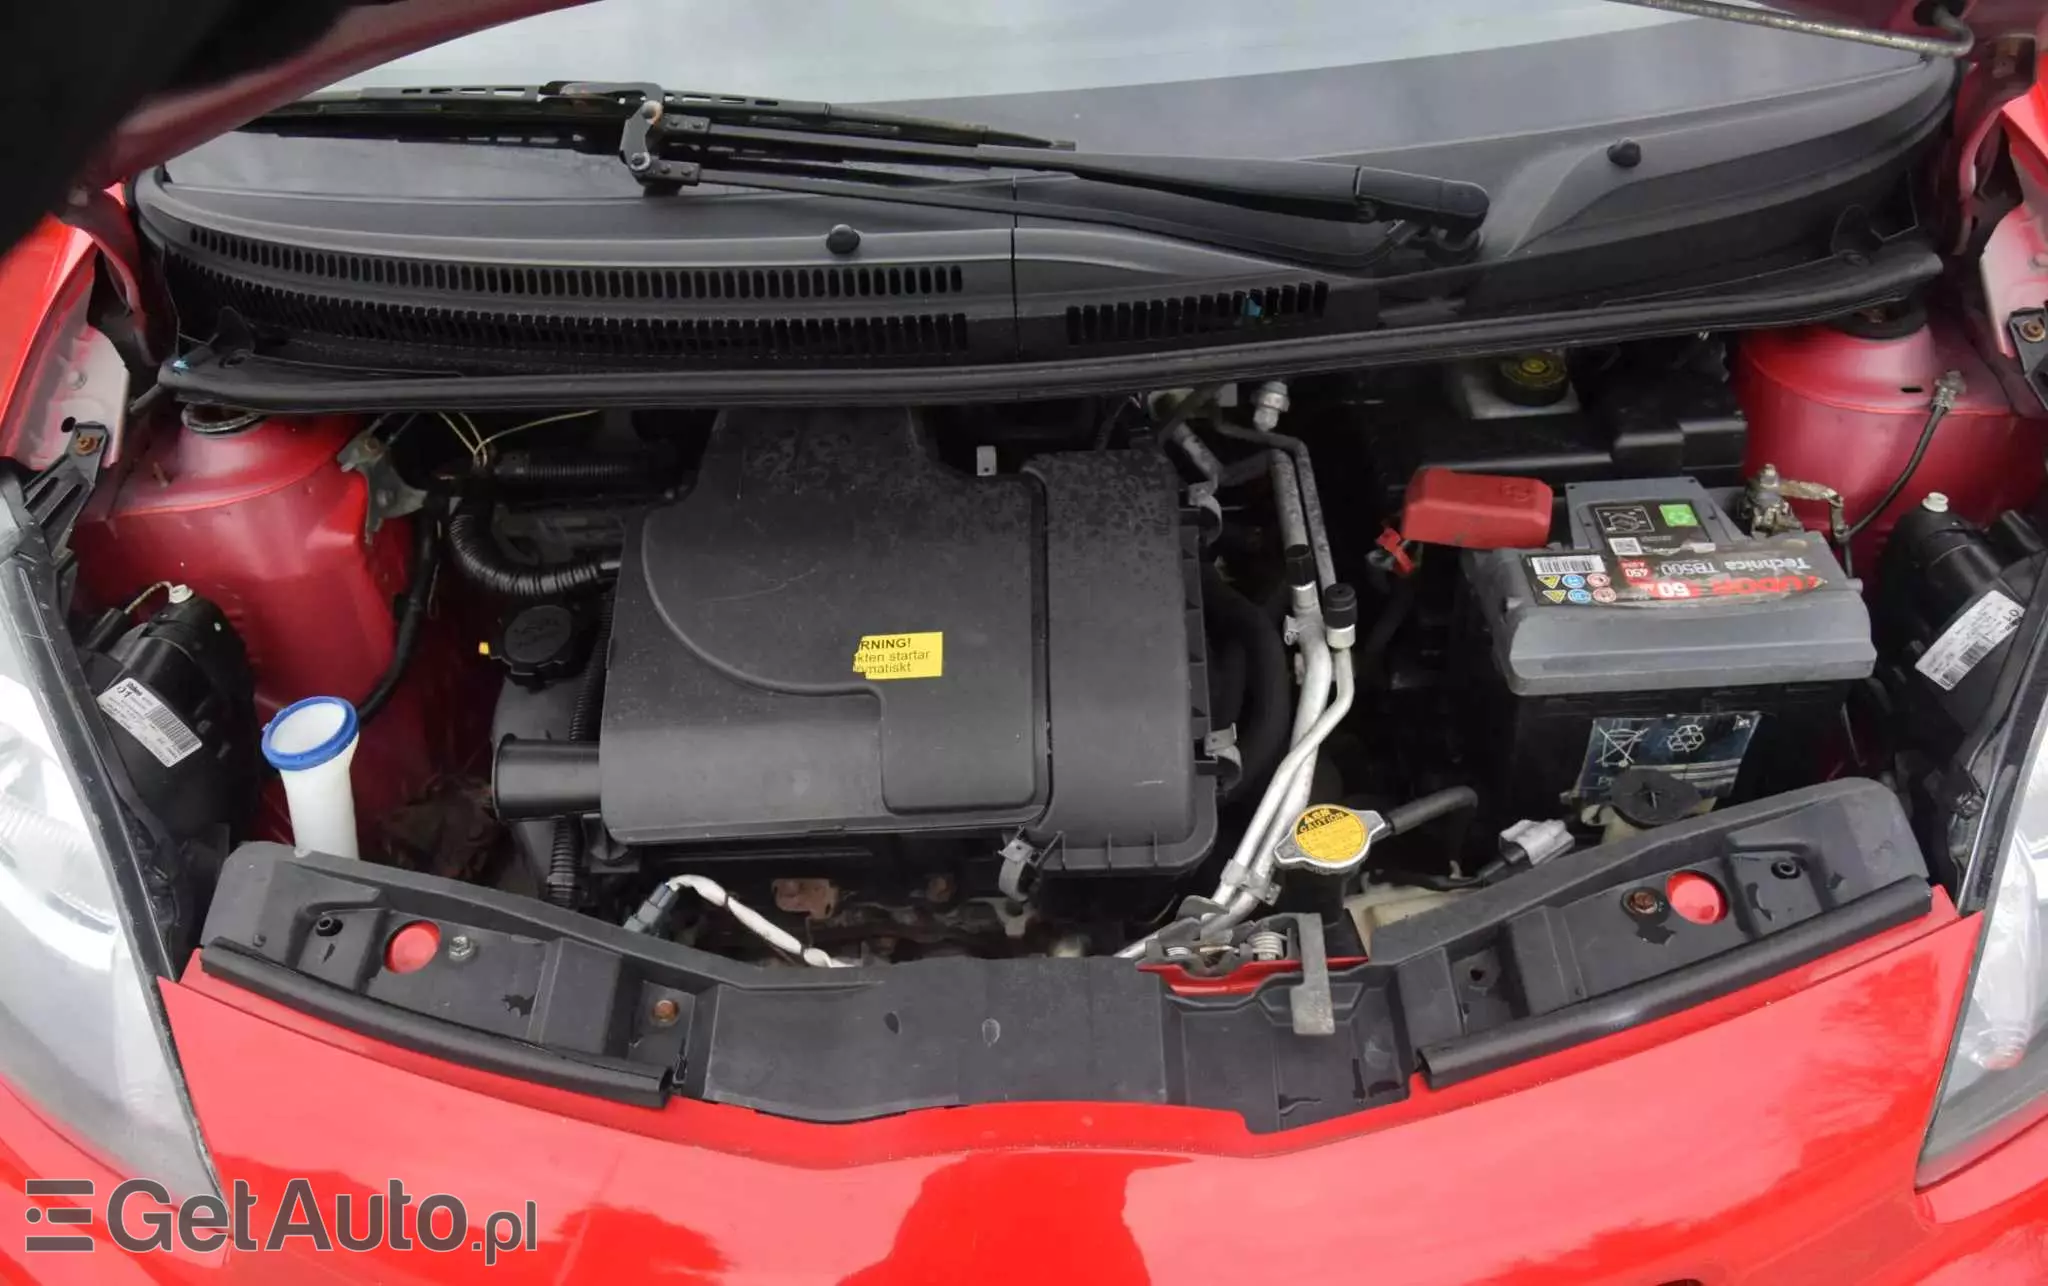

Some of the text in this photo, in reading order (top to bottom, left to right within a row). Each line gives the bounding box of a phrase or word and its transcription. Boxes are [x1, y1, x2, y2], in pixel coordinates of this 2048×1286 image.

[1661, 561, 1720, 575] TB500
[1724, 557, 1811, 571] Technica
[1657, 582, 1691, 598] 50
[861, 638, 911, 650] RNING!
[889, 650, 930, 661] startar
[1300, 812, 1346, 832] CAUTION
